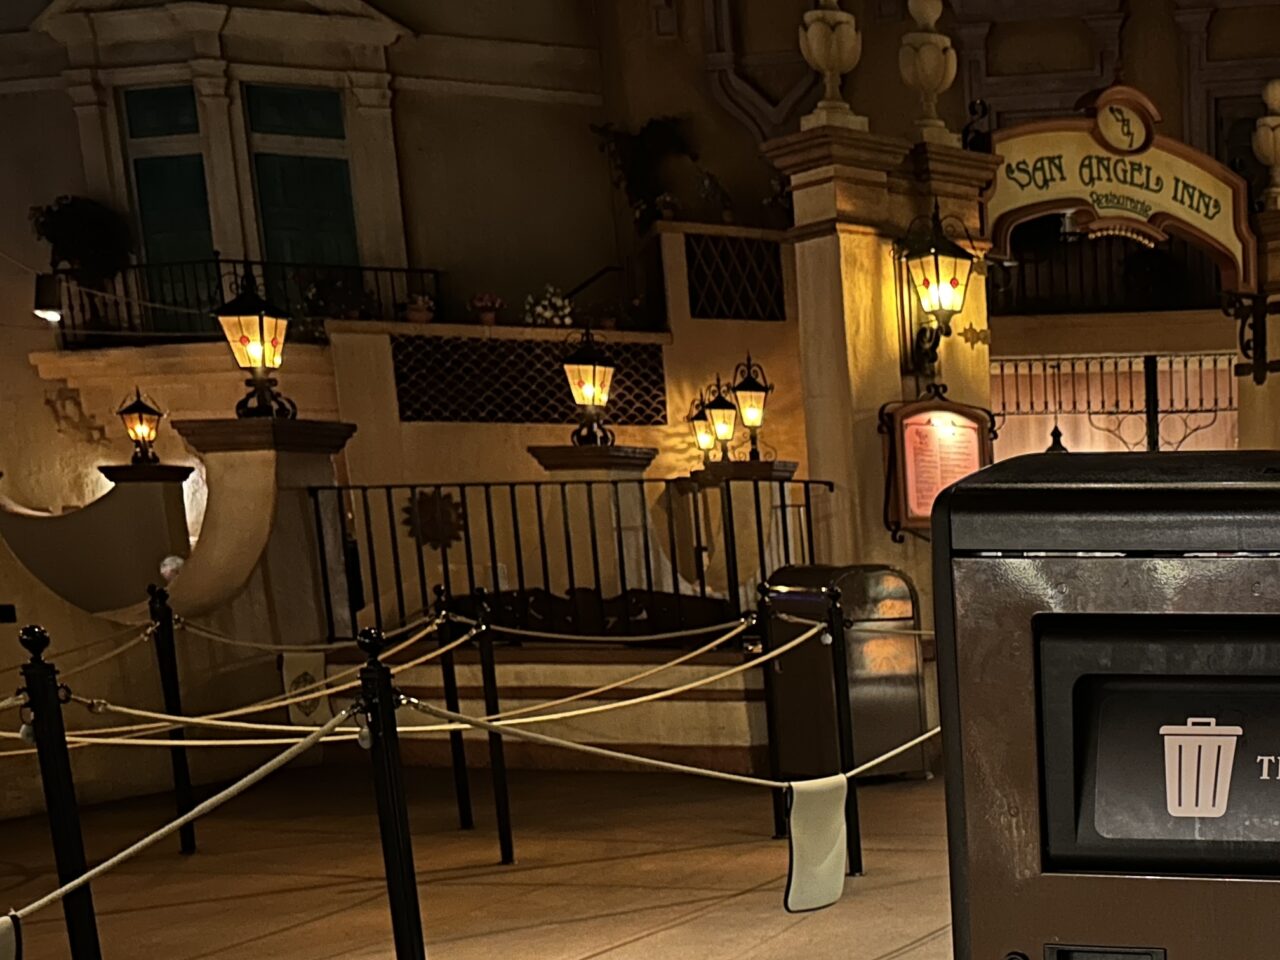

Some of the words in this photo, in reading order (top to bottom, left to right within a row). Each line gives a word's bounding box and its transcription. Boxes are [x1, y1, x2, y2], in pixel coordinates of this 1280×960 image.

[1006, 154, 1067, 191] SAN
[1079, 155, 1164, 194] ANGEL
[1171, 176, 1222, 221] INN
